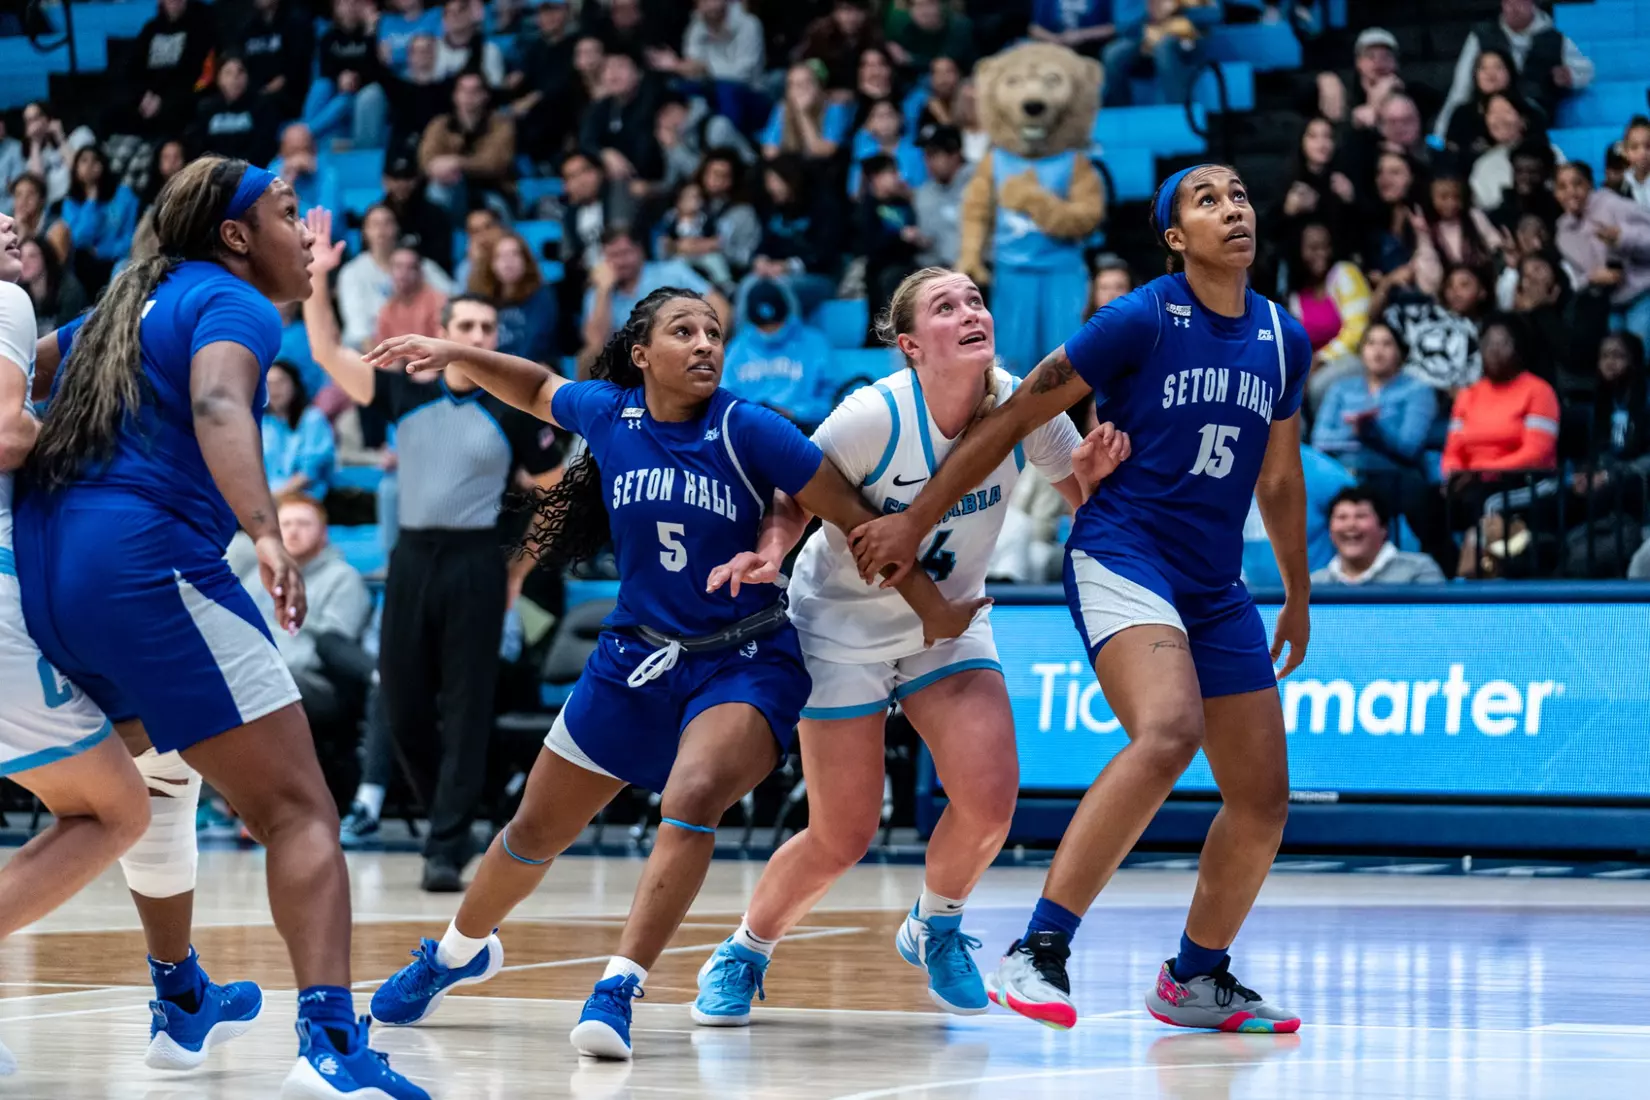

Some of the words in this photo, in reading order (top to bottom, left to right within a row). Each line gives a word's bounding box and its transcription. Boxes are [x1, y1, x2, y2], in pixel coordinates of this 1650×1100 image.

[1162, 367, 1229, 409] SETON
[1188, 423, 1241, 479] 15
[612, 467, 675, 510] SETON
[683, 469, 738, 522] HALL
[656, 520, 688, 573] 5
[921, 528, 957, 582] 4
